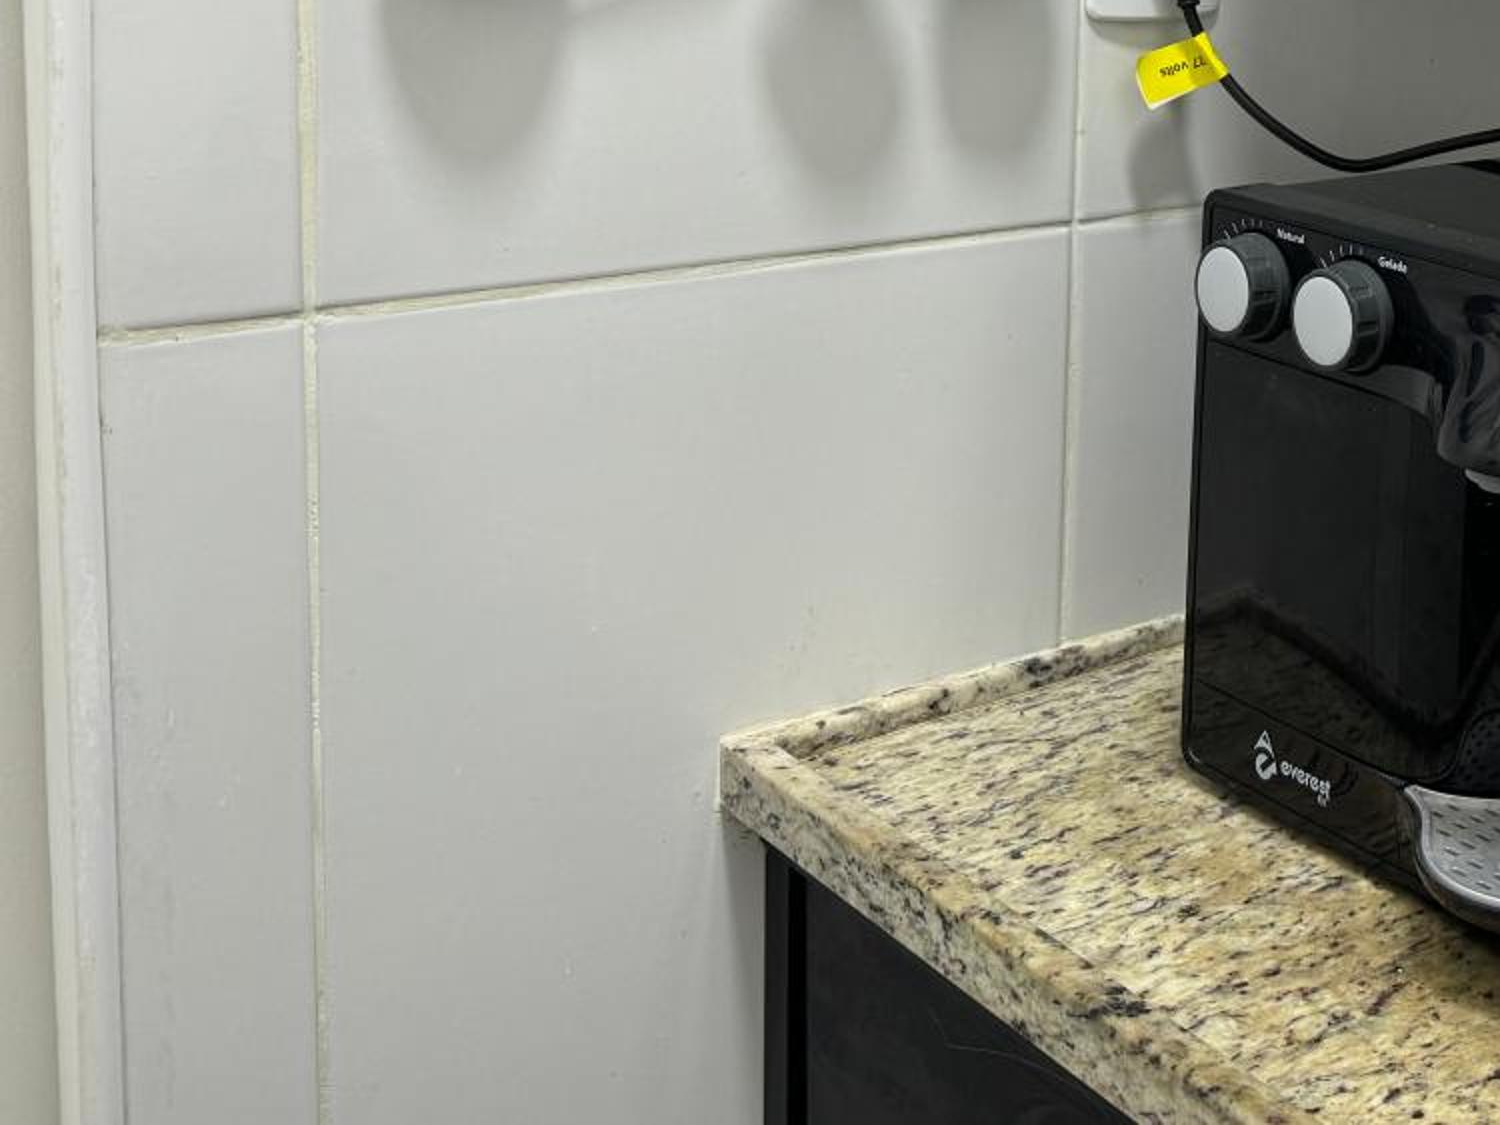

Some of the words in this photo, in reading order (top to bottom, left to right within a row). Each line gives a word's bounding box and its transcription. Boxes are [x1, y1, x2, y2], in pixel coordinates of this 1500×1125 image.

[1160, 61, 1189, 78] volts
[1277, 228, 1305, 244] Natural
[1377, 255, 1408, 274] Gelado
[1280, 760, 1331, 801] everest
